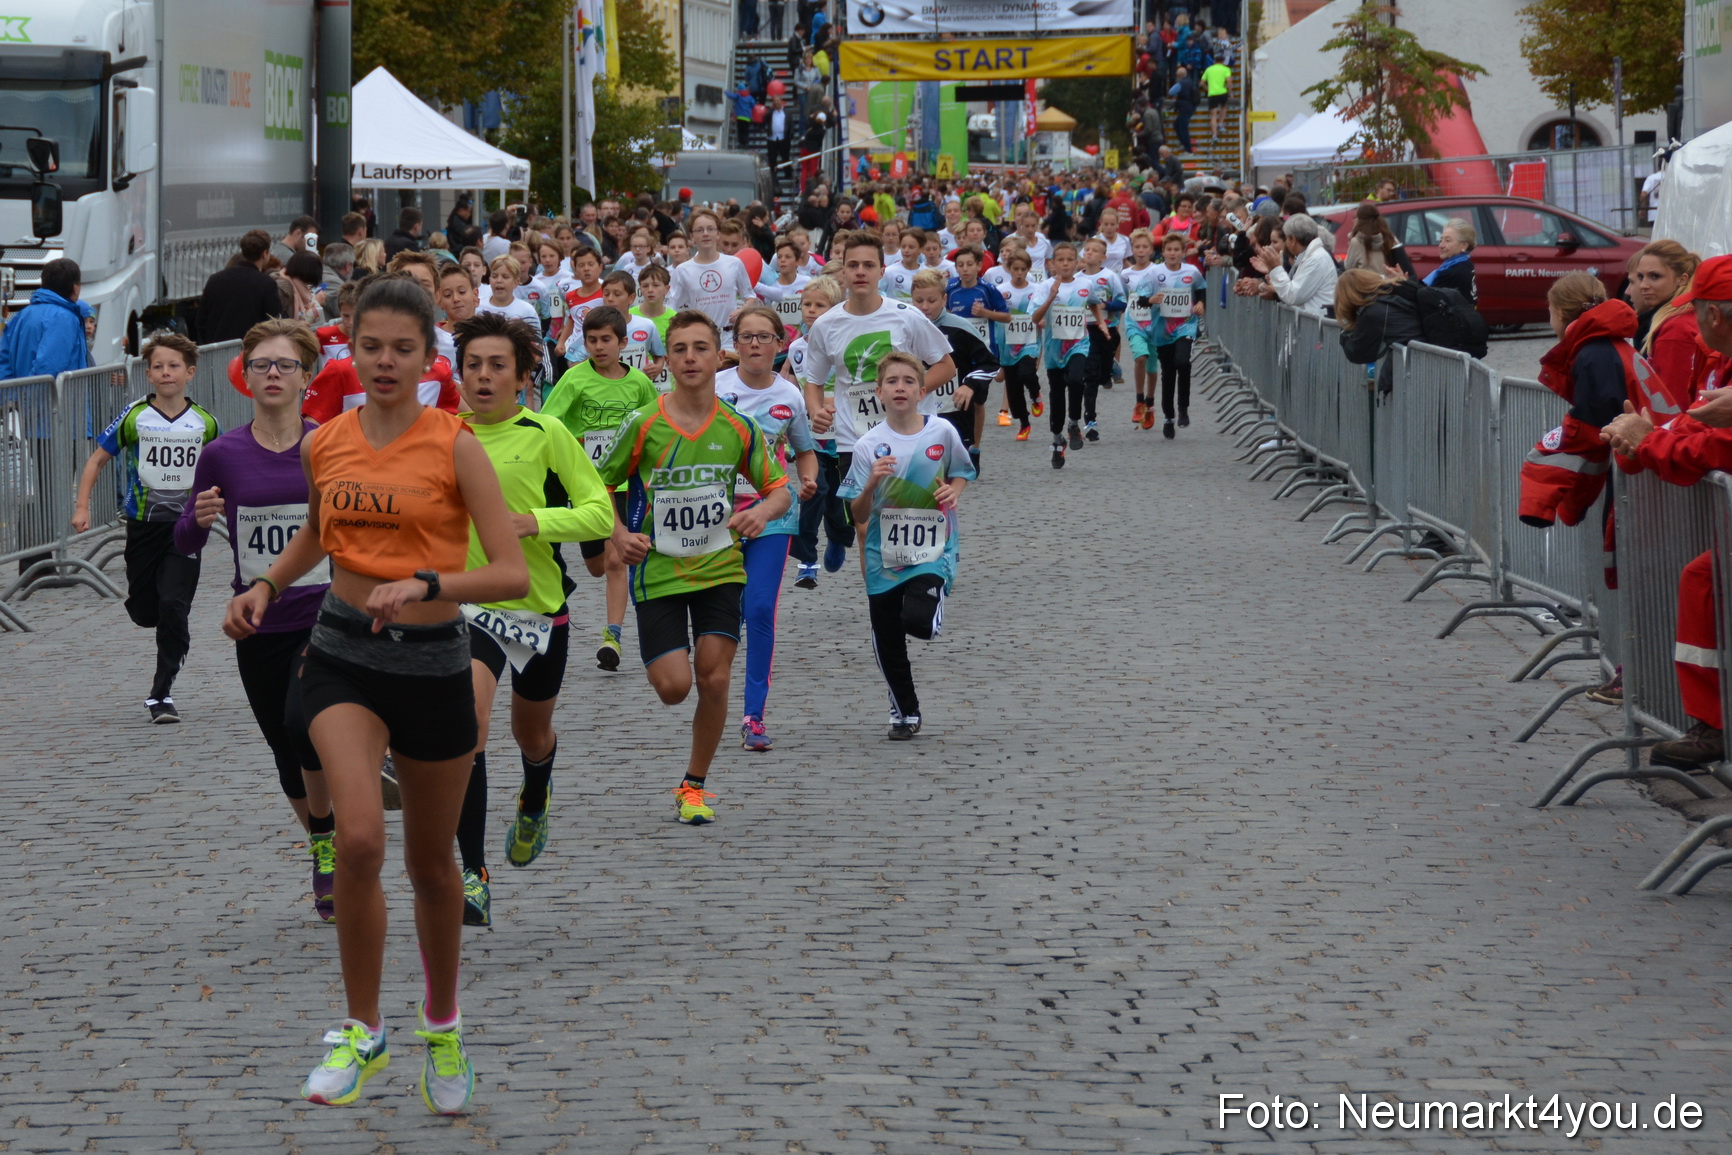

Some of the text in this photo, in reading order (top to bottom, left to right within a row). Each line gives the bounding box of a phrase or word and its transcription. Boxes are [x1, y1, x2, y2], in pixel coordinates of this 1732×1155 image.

[934, 46, 1033, 72] START
[264, 54, 303, 136] BOCK
[326, 94, 349, 124] BO
[361, 164, 452, 183] Laufsport
[1505, 268, 1537, 278] PARTL
[1164, 294, 1190, 306] 4000
[1008, 322, 1034, 333] 4104
[1056, 314, 1083, 327] 4102
[146, 446, 197, 468] 4036
[161, 473, 181, 482] Jens
[648, 464, 735, 488] BOCK
[330, 480, 363, 491] OPTIK
[332, 490, 401, 515] OEXL
[683, 492, 717, 504] Neumarkt
[239, 512, 309, 522] PARTL Neumark
[663, 501, 725, 532] 4043
[904, 514, 935, 522] Neumarkt
[248, 524, 301, 555] 40
[681, 535, 709, 547] David
[887, 523, 937, 547] 4101
[895, 551, 928, 563] Heiko
[473, 611, 540, 651] 4033
